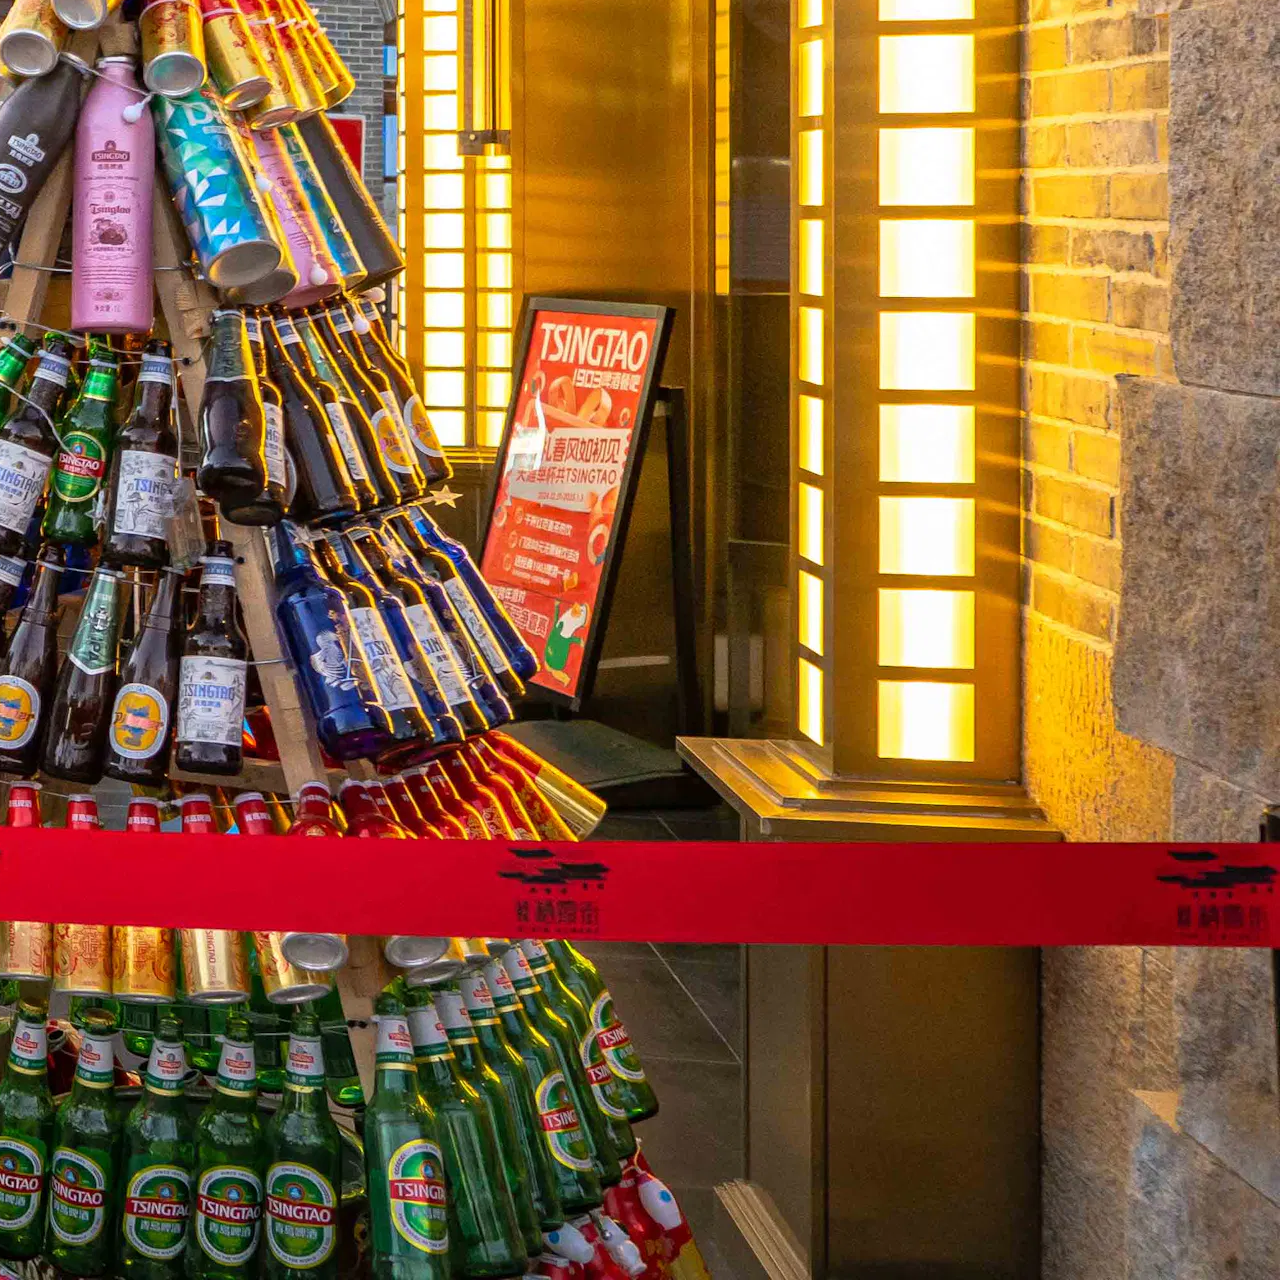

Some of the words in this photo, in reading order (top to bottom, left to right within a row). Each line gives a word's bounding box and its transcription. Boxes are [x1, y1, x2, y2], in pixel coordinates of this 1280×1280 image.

[540, 322, 648, 372] TSINGTAO
[59, 452, 100, 471] TSINGTAO
[183, 683, 236, 701] TSINGTAO
[200, 1196, 261, 1220] TSINGTAO
[267, 1196, 332, 1223] TSINGTAO
